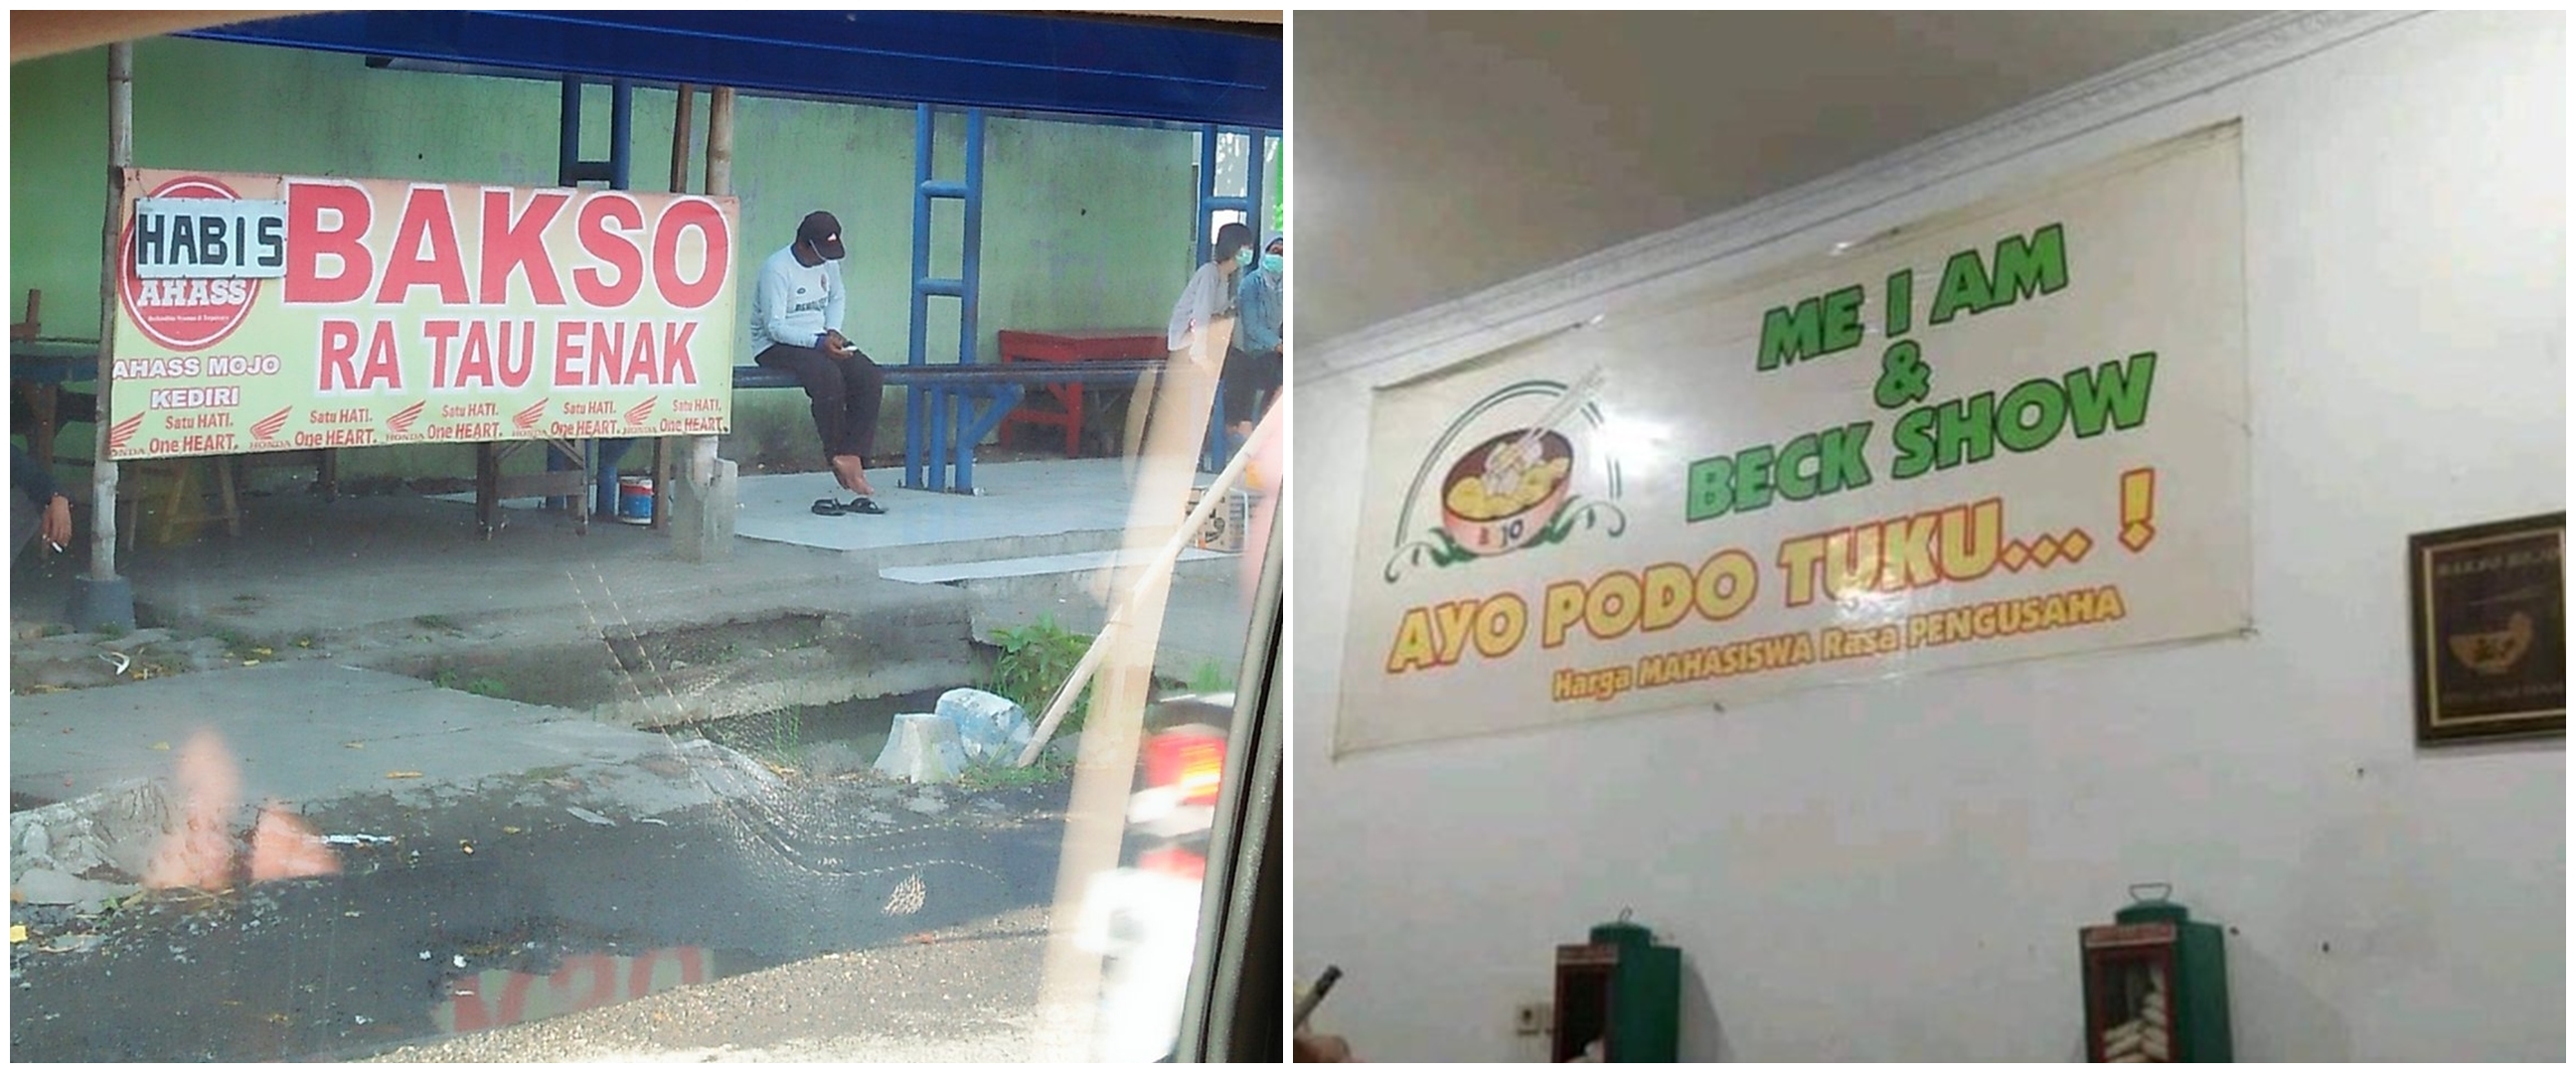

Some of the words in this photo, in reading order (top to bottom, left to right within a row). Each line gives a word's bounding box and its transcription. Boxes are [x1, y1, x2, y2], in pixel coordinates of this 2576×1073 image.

[137, 213, 284, 268] HABIS
[283, 179, 730, 310] BAKSO
[137, 279, 247, 308] AHASS
[1757, 284, 1864, 372] ME
[1885, 268, 1913, 338] I
[1928, 223, 2070, 325] AM
[318, 319, 402, 391] RA
[423, 319, 537, 389] TAU
[553, 320, 699, 387] ENAK
[112, 356, 201, 380] AHASS
[207, 355, 281, 378] MOJO
[1872, 340, 1932, 409] &
[150, 386, 240, 409] KEDIRI
[310, 409, 337, 423] Satu
[442, 404, 465, 418] Satu
[563, 401, 586, 415] Satu
[165, 415, 195, 429] Satu
[427, 423, 453, 439] One
[551, 420, 574, 436] One
[659, 417, 682, 432] One
[149, 438, 179, 454] One
[294, 430, 323, 446] One
[386, 432, 424, 441] HONDA
[1686, 421, 1873, 524] BECK
[1891, 351, 2158, 480] SHOW
[110, 448, 145, 457] ONDA
[1386, 591, 1528, 675] AYO
[1541, 548, 1759, 649] PODO
[1552, 667, 1631, 702] Harga
[1637, 633, 1816, 690] MAHASISWA
[1819, 624, 1898, 662] Rasa
[1905, 584, 2127, 650] PENGUSAHA
